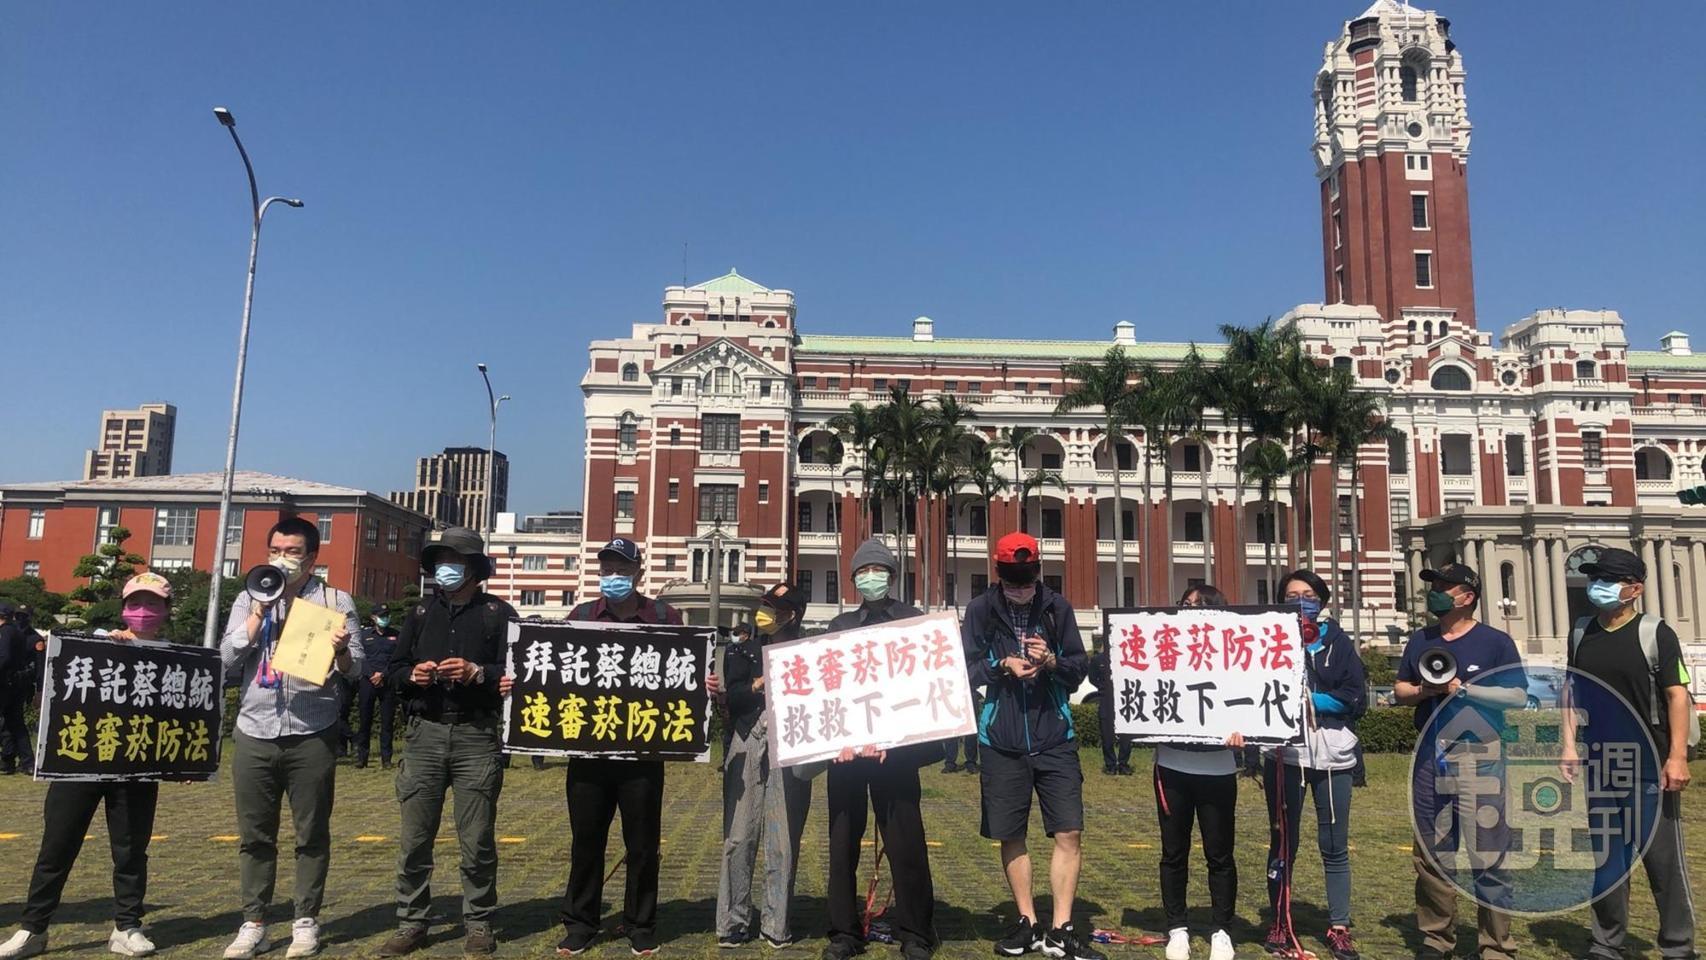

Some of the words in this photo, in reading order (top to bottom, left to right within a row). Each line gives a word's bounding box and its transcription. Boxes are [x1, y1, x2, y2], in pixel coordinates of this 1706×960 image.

[522, 640, 698, 691] 拜託蔡總統
[780, 629, 955, 696] 速審菸防法
[1119, 623, 1294, 672] 速審菸防法
[63, 655, 214, 711] 拜託蔡總統
[1119, 678, 1296, 729] 救救下一代
[57, 711, 211, 762] 速審菸防法
[520, 691, 696, 743] 速審菸防法
[782, 677, 962, 748] 救救下一代
